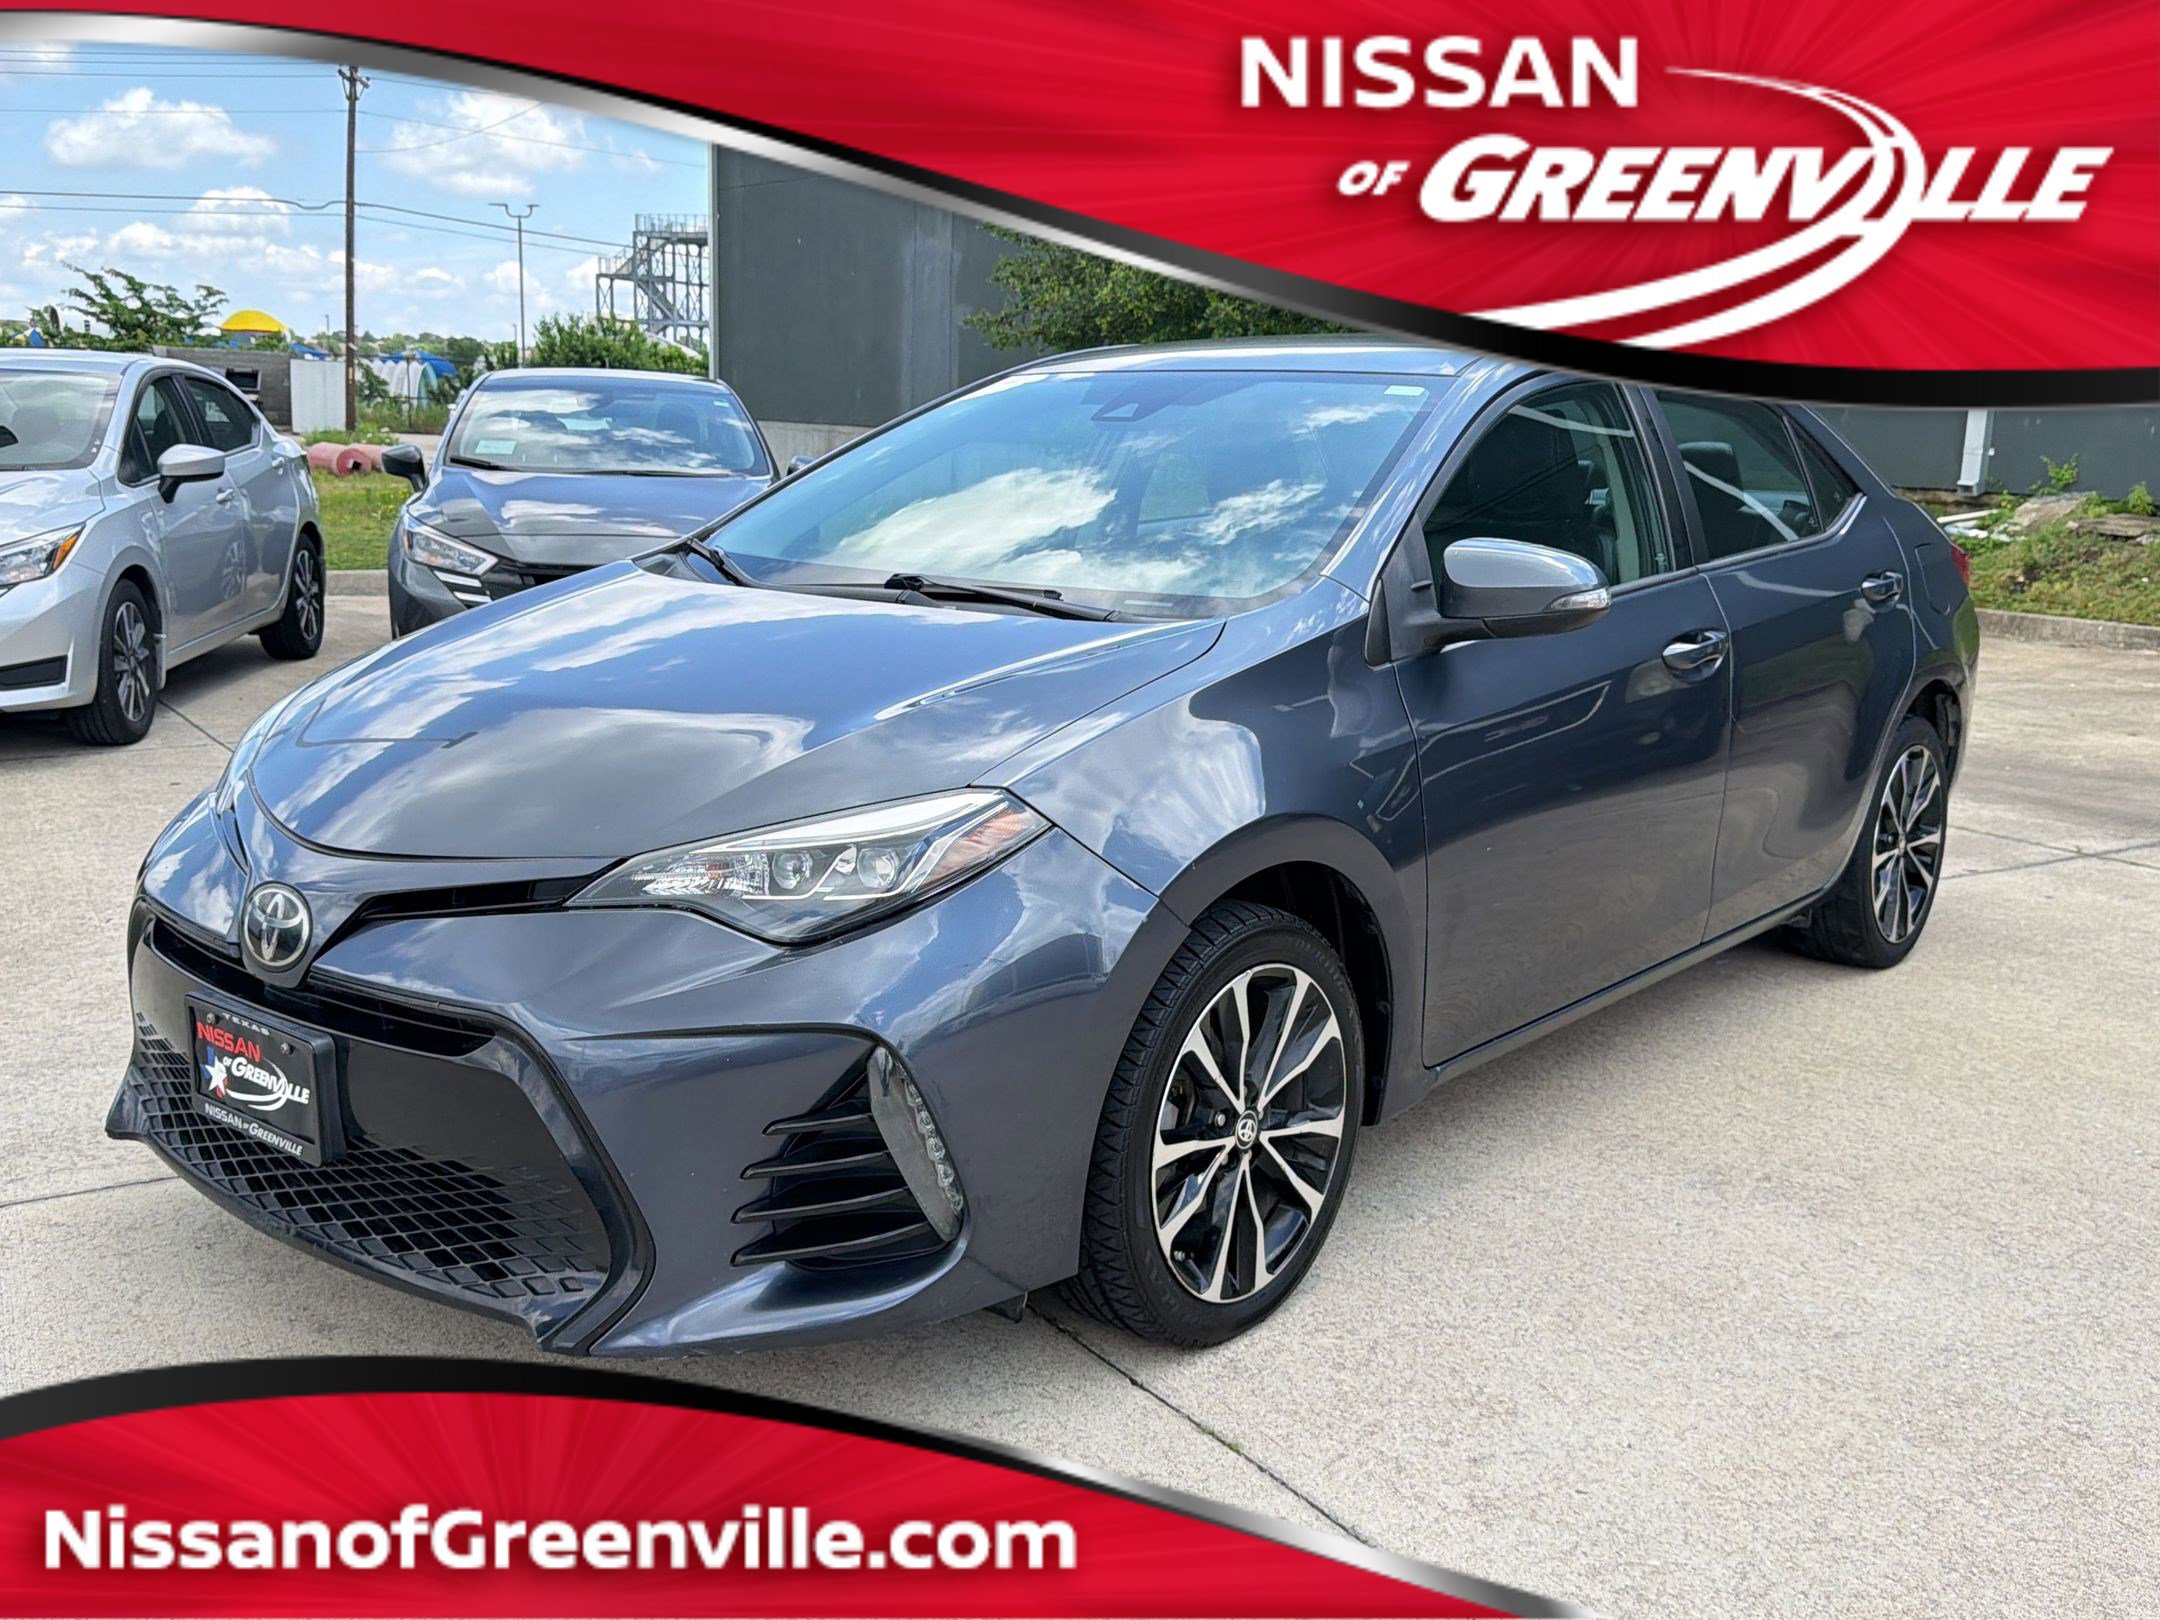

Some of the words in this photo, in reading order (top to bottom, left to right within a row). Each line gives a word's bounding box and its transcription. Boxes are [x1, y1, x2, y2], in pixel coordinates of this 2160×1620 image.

[197, 1021, 261, 1063] NISSAN
[222, 1012, 271, 1036] TEXAS
[231, 1057, 310, 1105] GREENVILLE
[204, 1102, 243, 1129] NISSAN
[249, 1122, 304, 1156] GREENVILLE
